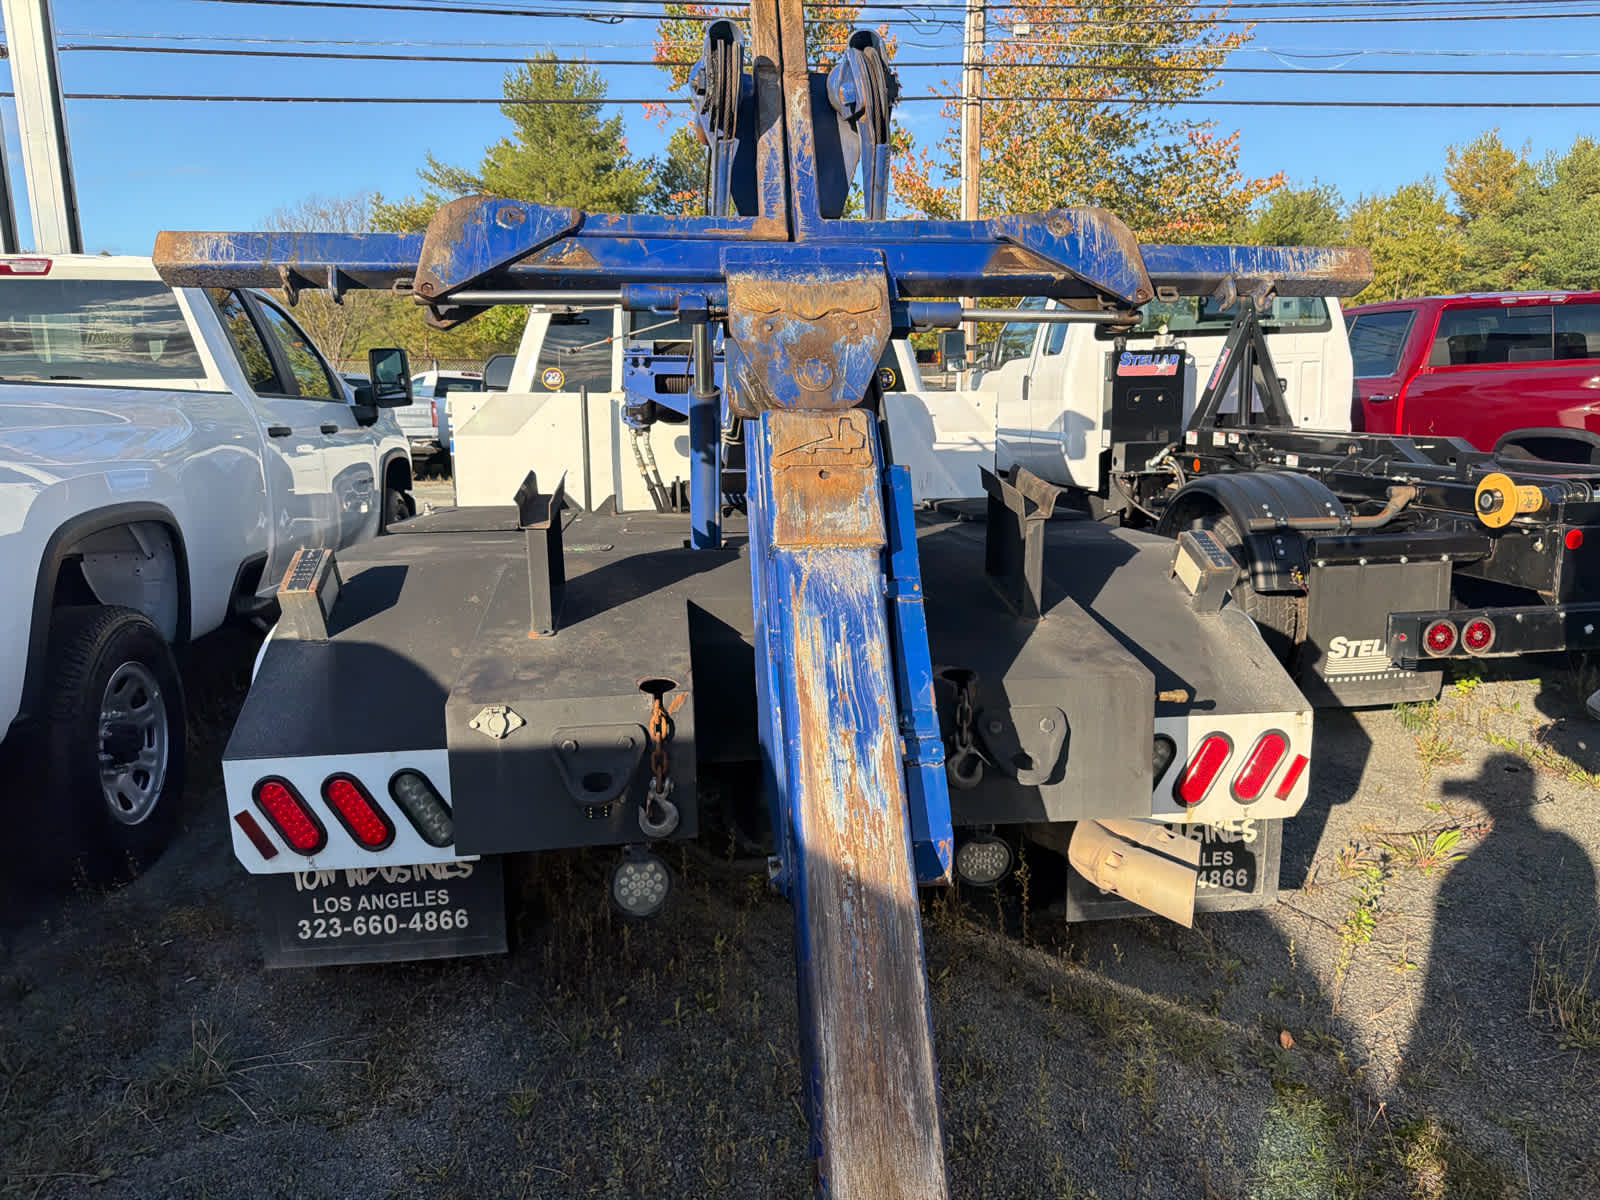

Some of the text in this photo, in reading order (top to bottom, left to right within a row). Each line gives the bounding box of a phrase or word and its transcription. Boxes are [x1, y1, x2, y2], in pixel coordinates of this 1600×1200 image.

[1120, 352, 1180, 366] STELLAR
[312, 889, 450, 914] LOS ANGELES
[298, 909, 469, 939] 323-660-4866
